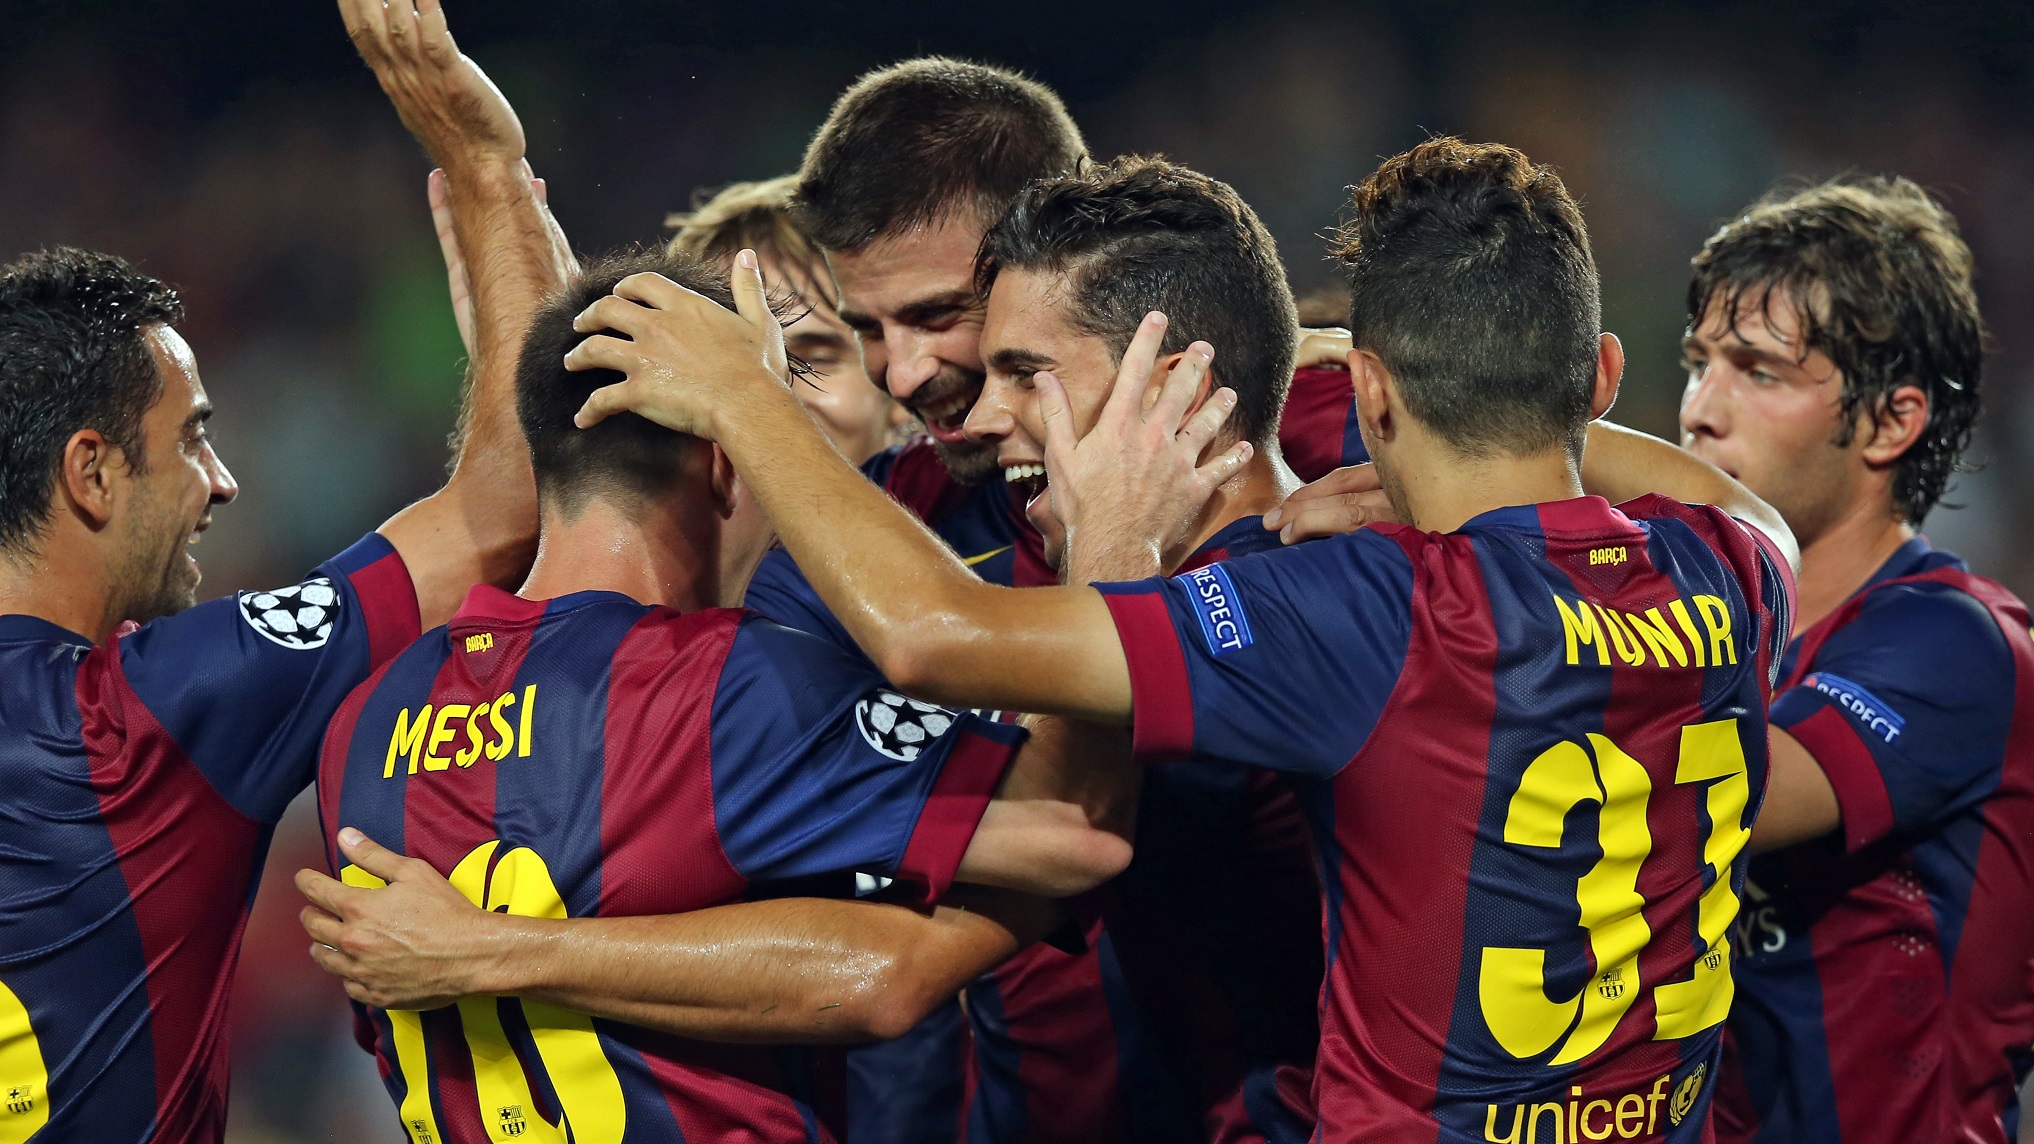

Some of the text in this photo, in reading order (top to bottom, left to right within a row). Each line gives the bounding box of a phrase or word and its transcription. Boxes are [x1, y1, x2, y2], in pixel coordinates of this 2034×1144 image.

[1589, 546, 1627, 566] BARÇA
[465, 632, 494, 653] BARÇA
[1190, 568, 1242, 649] RESPECT
[1553, 594, 1738, 668] MUNIR
[383, 683, 538, 779] MESSI
[1478, 718, 1751, 1066] 31
[1484, 1074, 1670, 1144] unicef
